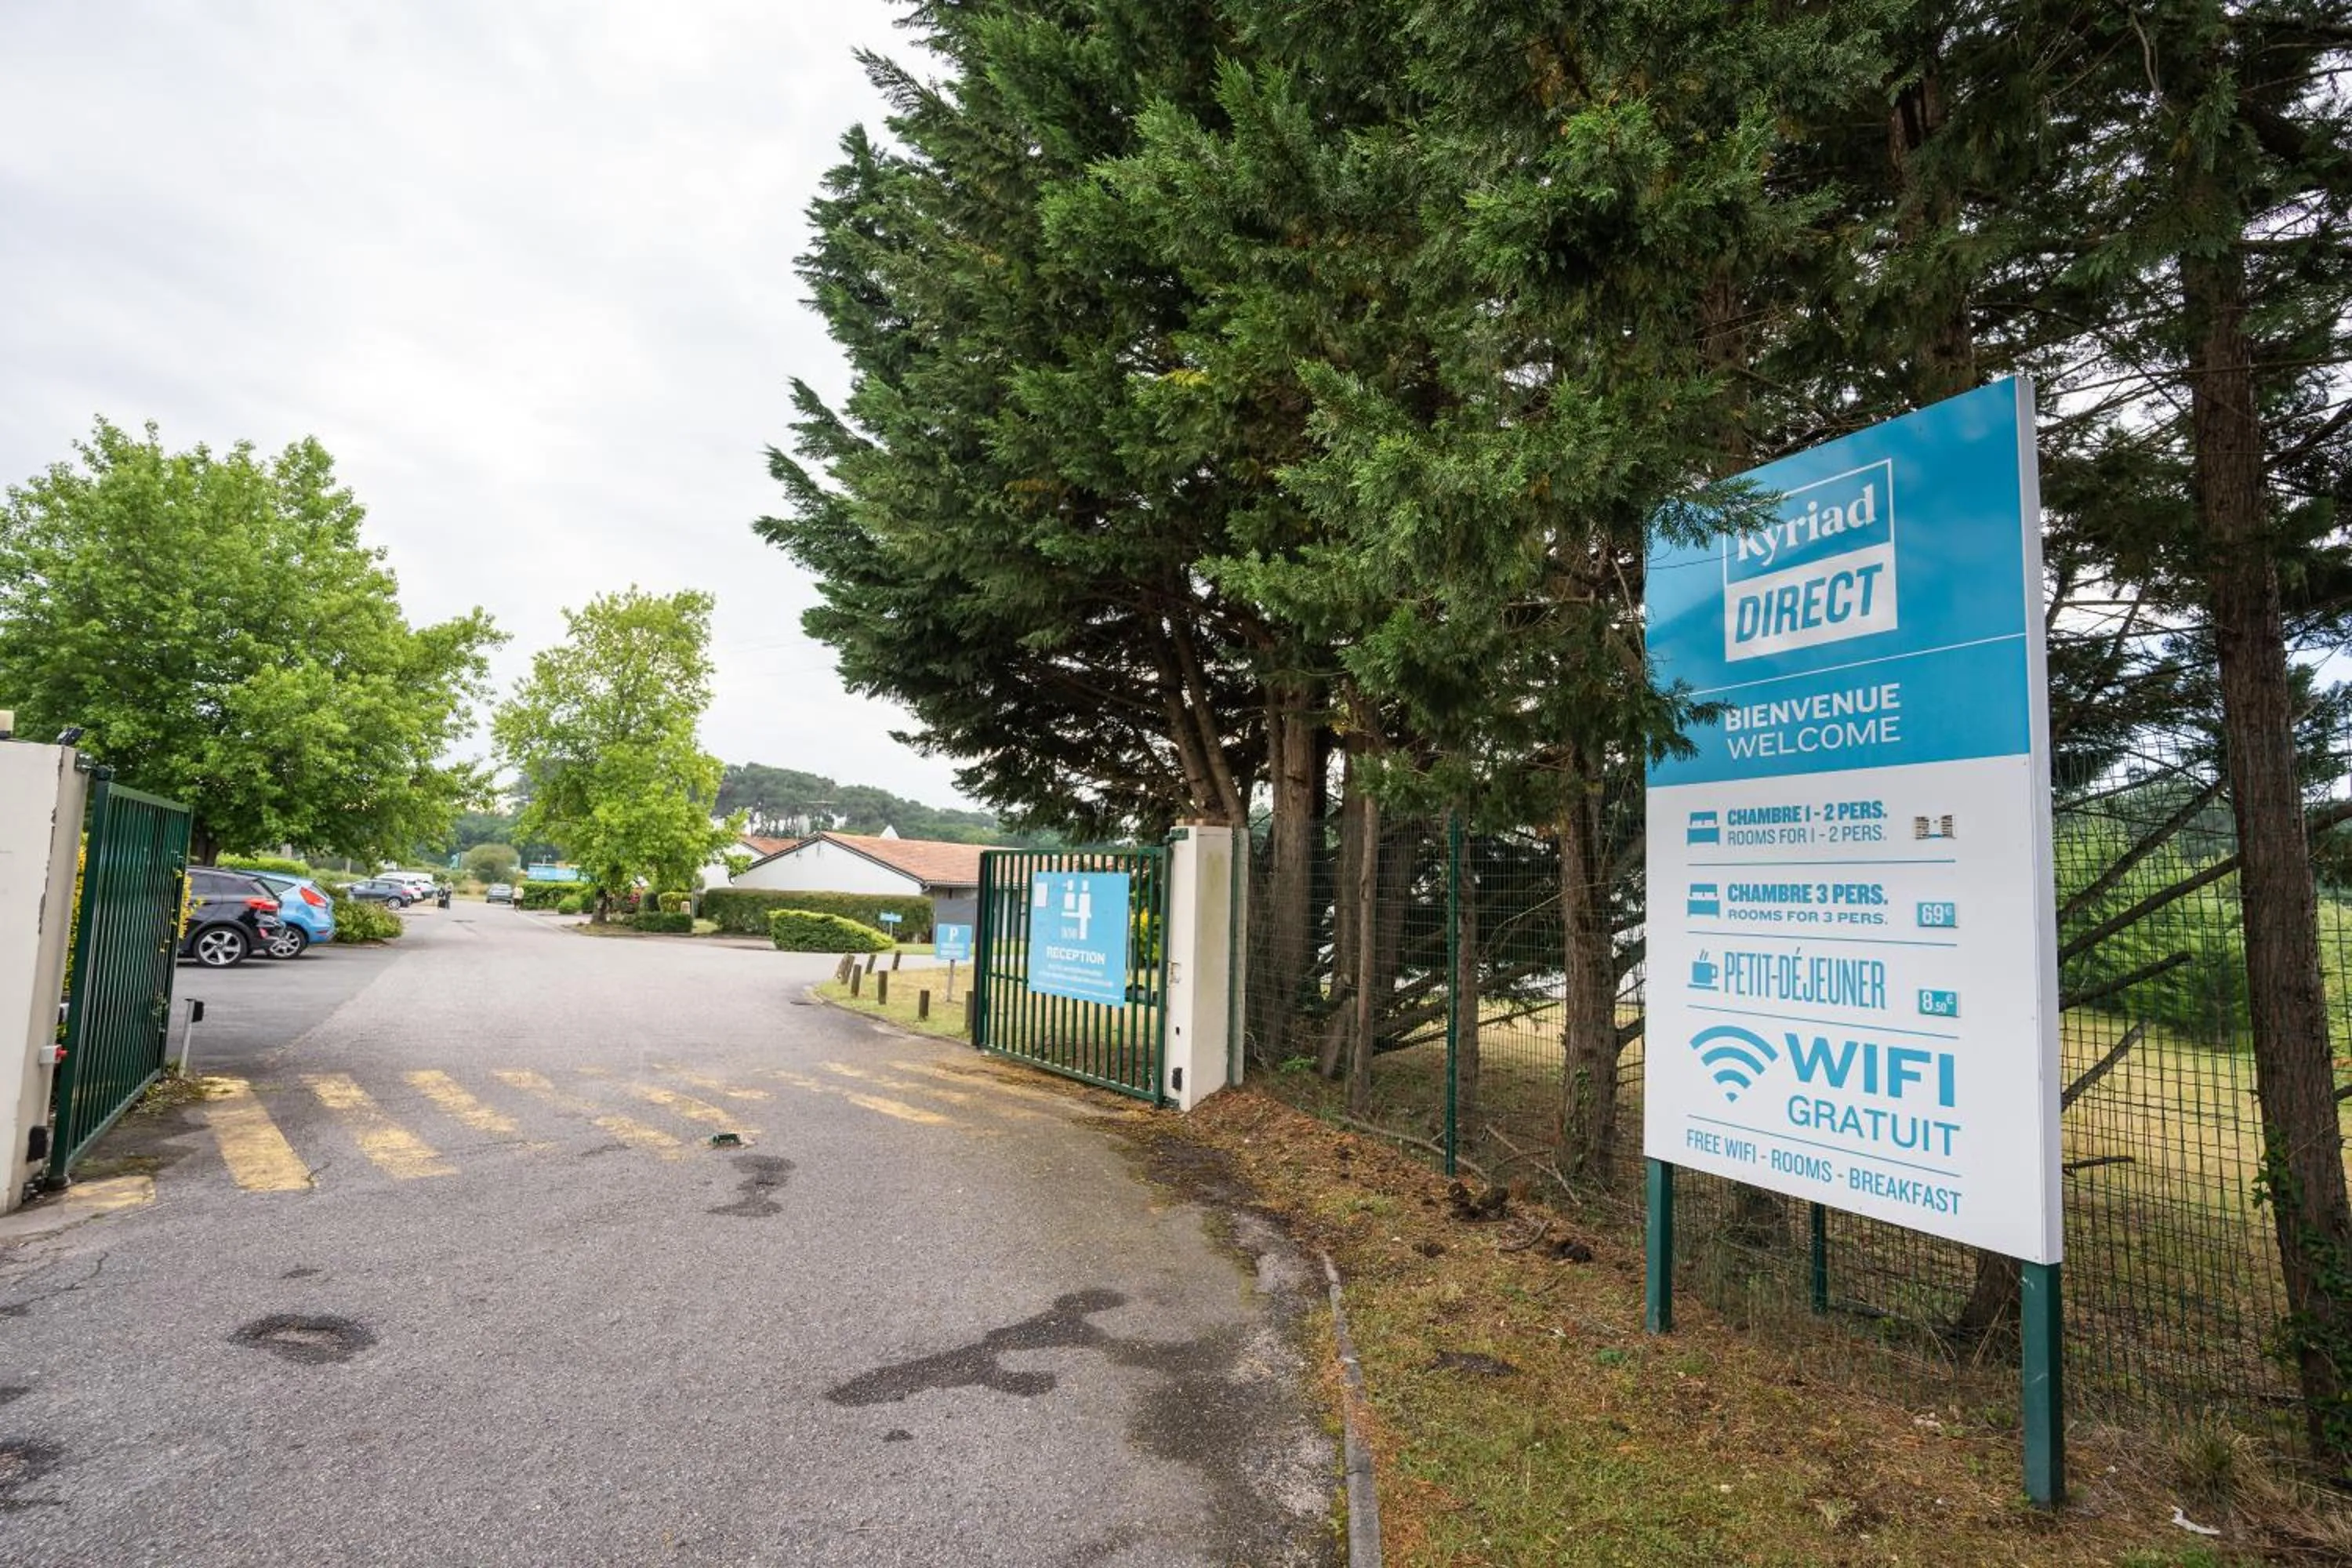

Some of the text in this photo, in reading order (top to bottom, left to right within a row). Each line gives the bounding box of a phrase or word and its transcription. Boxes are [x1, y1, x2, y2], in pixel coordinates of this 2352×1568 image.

[1735, 563, 1883, 643] DIRECT
[1725, 682, 1901, 731] BIENVENUE
[1727, 715, 1901, 760] WELCOME
[1727, 805, 1802, 826] CHAMBRE
[1824, 804, 1835, 821] 2
[1838, 800, 1888, 820] PERS.
[1727, 829, 1776, 845] ROOMS
[1779, 828, 1807, 844] FOR
[1829, 826, 1838, 842] 2
[1842, 824, 1887, 841] PERS.
[1727, 883, 1889, 906] CHAMBRE 3 PERS.
[1728, 909, 1889, 925] ROOMS FOR 3 PERS.
[949, 927, 959, 942] P
[1047, 946, 1105, 964] RECEPTION
[1724, 947, 1886, 1011] PETIT-DÉJEUNER
[1784, 1032, 1955, 1108] WIFI
[1788, 1094, 1961, 1156] GRATUIT
[1686, 1128, 1721, 1156] FREE
[1725, 1138, 1756, 1164] WIFI
[1771, 1149, 1832, 1183] ROOMS
[1849, 1167, 1962, 1215] BREAKFAST
